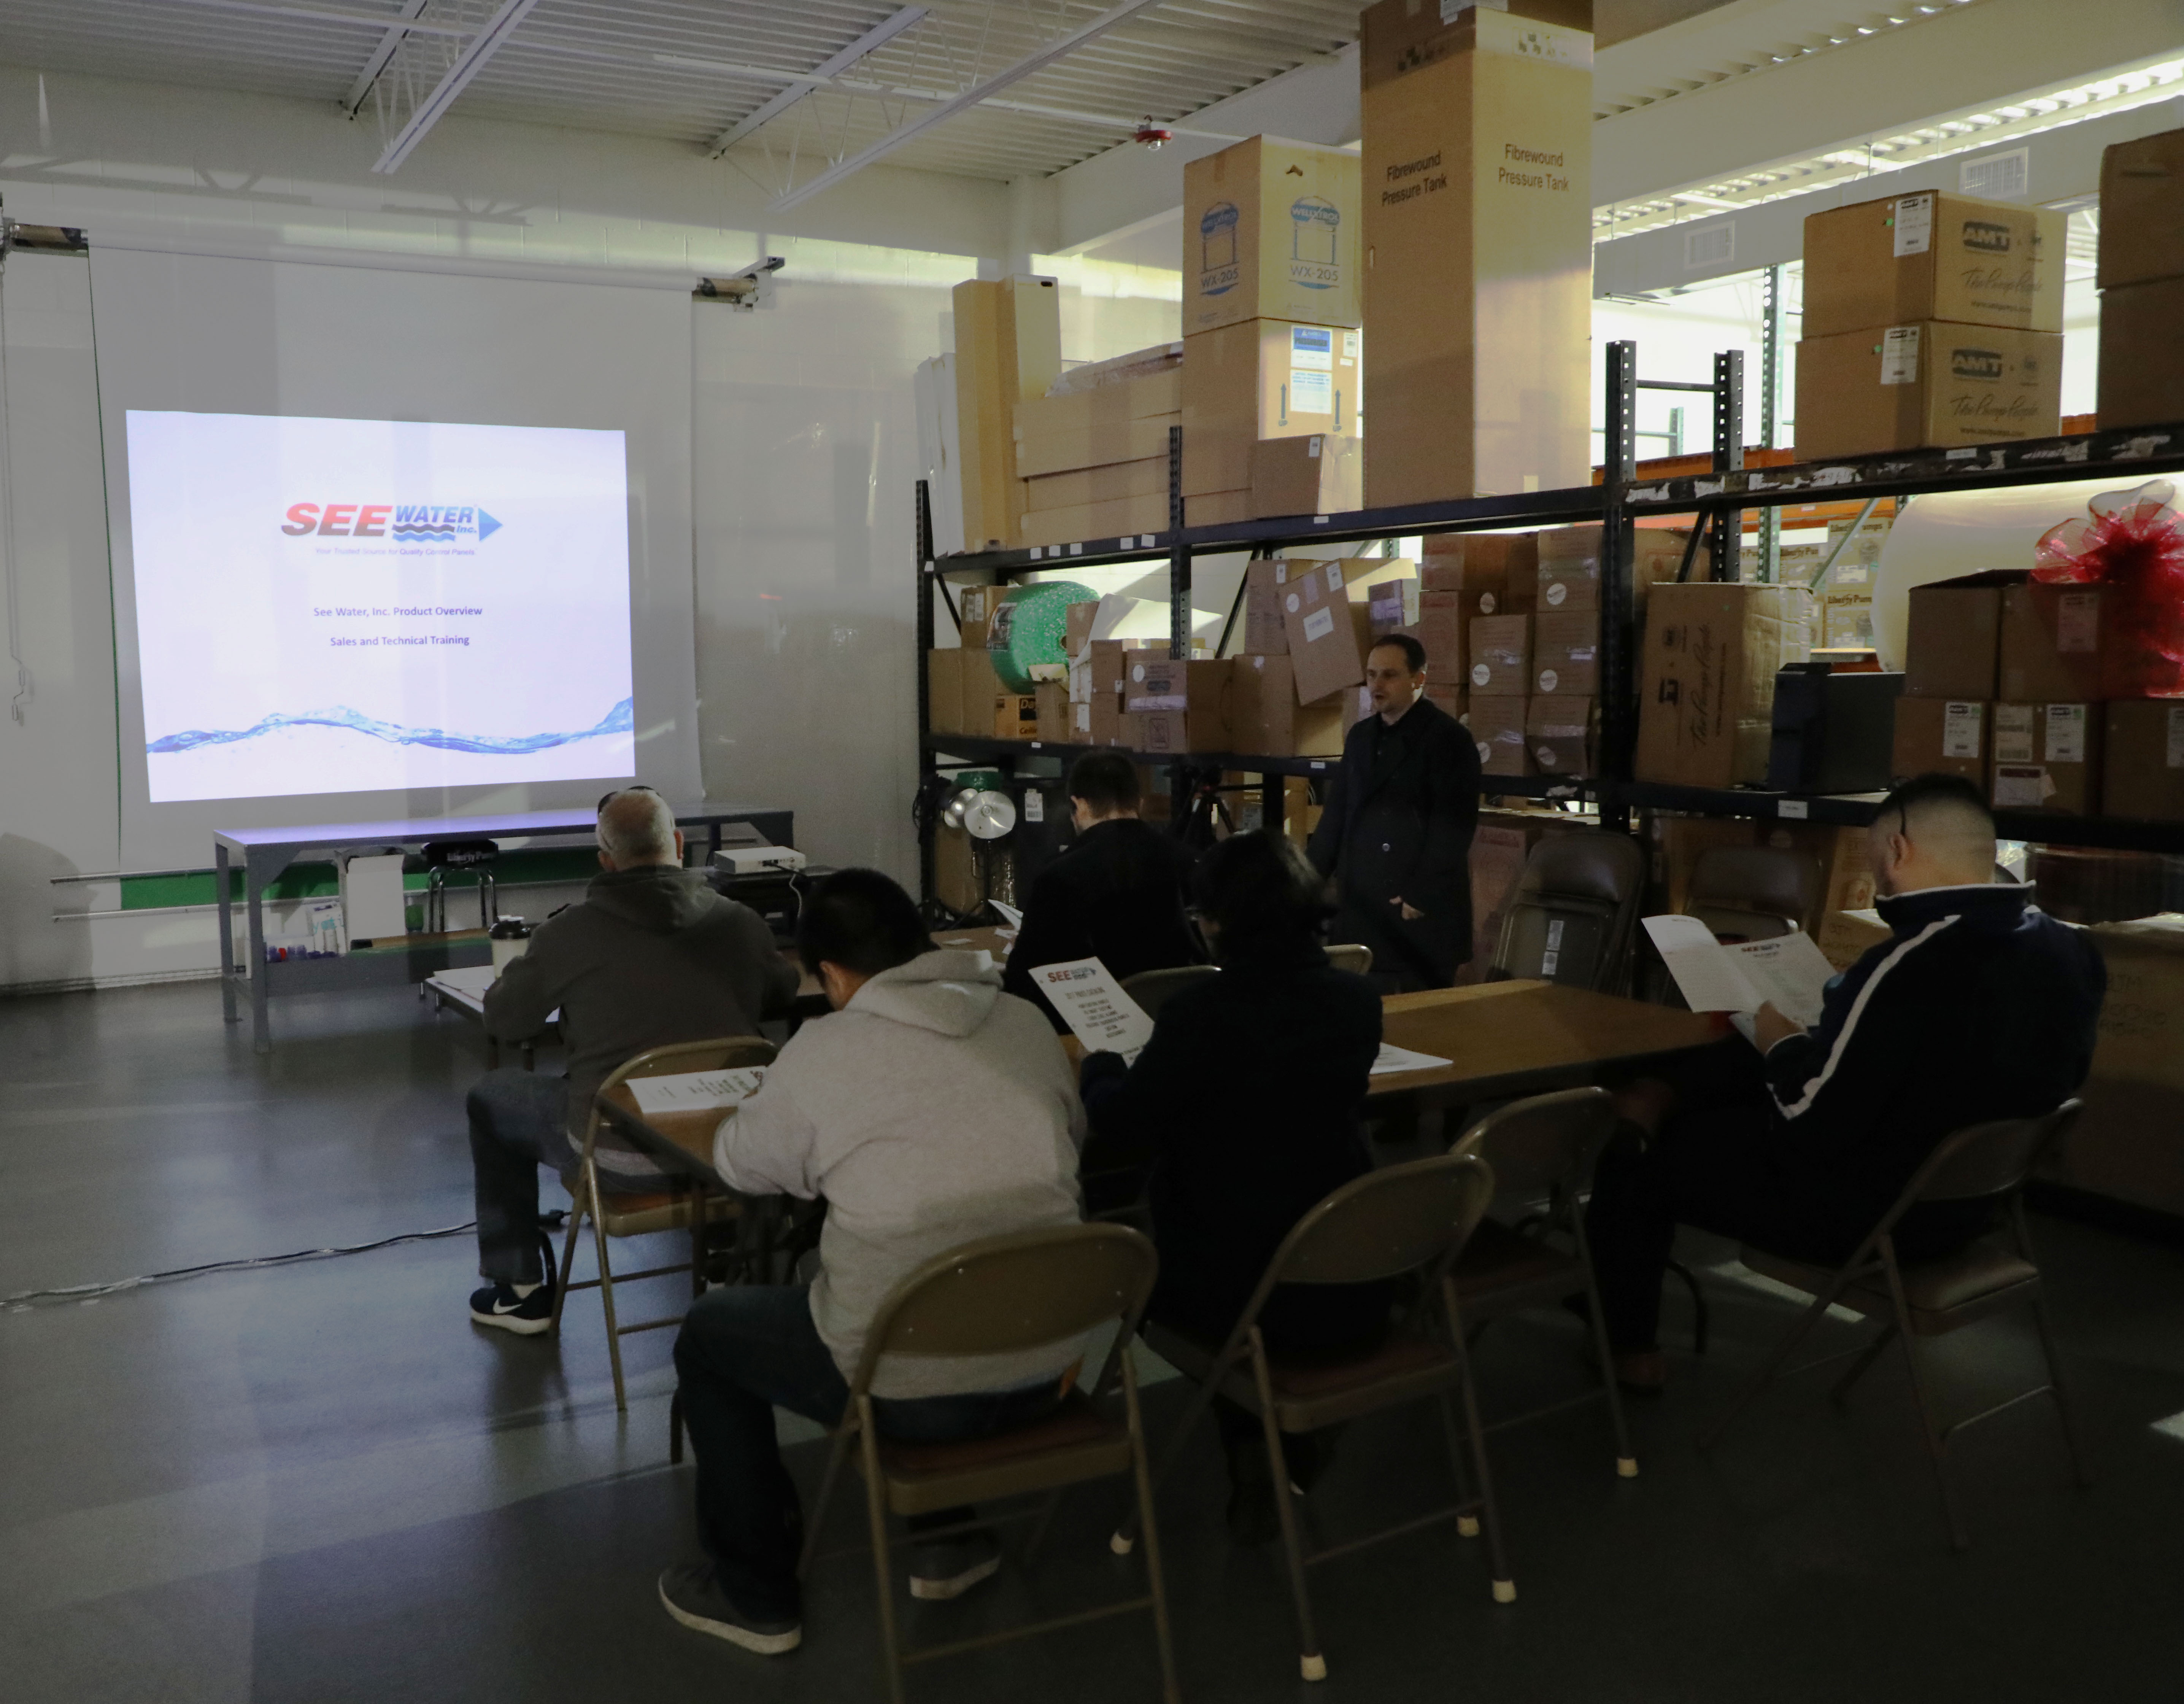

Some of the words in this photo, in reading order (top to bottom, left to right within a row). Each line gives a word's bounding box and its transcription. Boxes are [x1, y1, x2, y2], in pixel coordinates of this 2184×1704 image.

[1505, 143, 1563, 167] Fibrewound
[1387, 150, 1441, 182] Fibrewound
[1498, 167, 1542, 188] Pressure
[1546, 173, 1569, 191] Tank
[1382, 184, 1421, 207] Pressure
[1423, 173, 1447, 194] Tank
[1963, 225, 2010, 248] AMT
[1202, 268, 1239, 287] WX-205
[1290, 265, 1339, 281] WX-205
[1952, 353, 2002, 375] AMT
[281, 503, 393, 536] SEE
[396, 505, 474, 523] WATER
[400, 548, 423, 556] Quality
[314, 607, 332, 617] See
[335, 607, 369, 618] Water,
[393, 607, 433, 616] Product
[435, 606, 483, 615] Overview
[330, 637, 357, 646] Sales
[360, 636, 379, 645] and
[381, 636, 428, 645] Technical
[430, 635, 470, 646] Training
[1047, 970, 1072, 983] SEE
